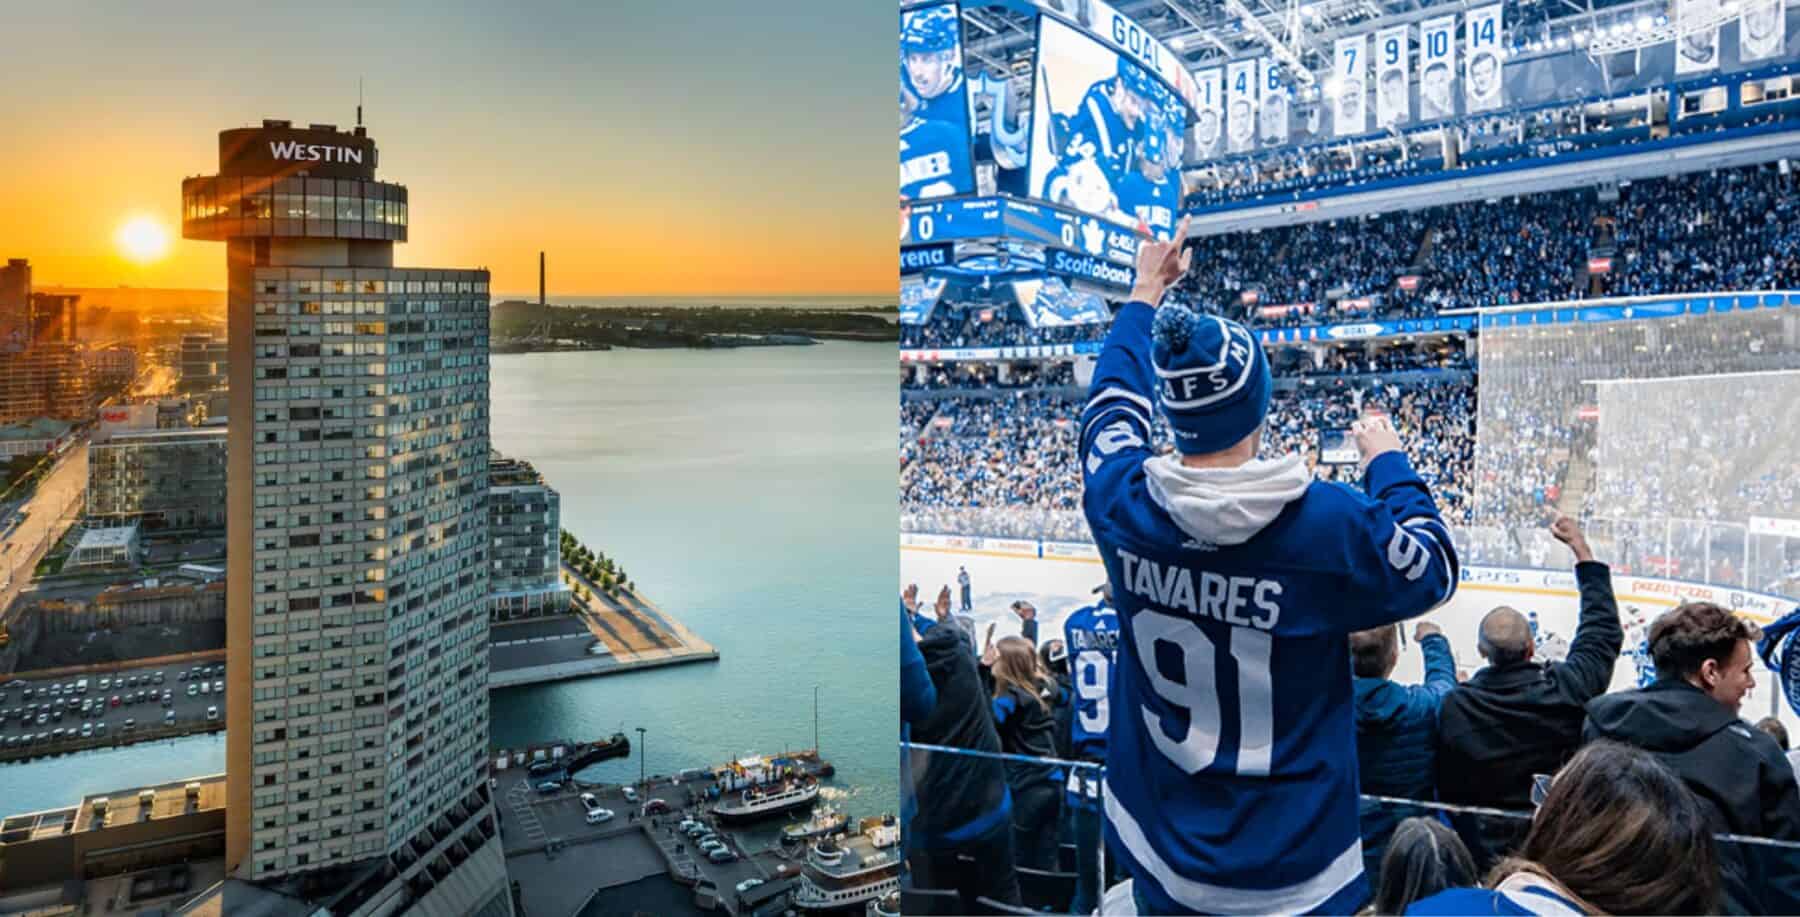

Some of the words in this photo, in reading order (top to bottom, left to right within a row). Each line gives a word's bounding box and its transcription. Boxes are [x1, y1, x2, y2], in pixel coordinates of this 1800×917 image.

[1112, 14, 1162, 72] GOAL
[1426, 31, 1448, 59] 10
[1472, 18, 1496, 48] 14
[1344, 50, 1358, 75] 7
[1384, 39, 1399, 65] 9
[1235, 71, 1247, 94] 4
[1267, 65, 1281, 90] 6
[1204, 81, 1211, 105] 1
[269, 140, 363, 165] WESTIN
[918, 215, 934, 240] 0
[1061, 223, 1074, 247] 0
[900, 249, 945, 268] rena
[1055, 252, 1133, 286] Scotiabank
[1116, 548, 1284, 630] TAVARES
[1130, 608, 1273, 776] 91
